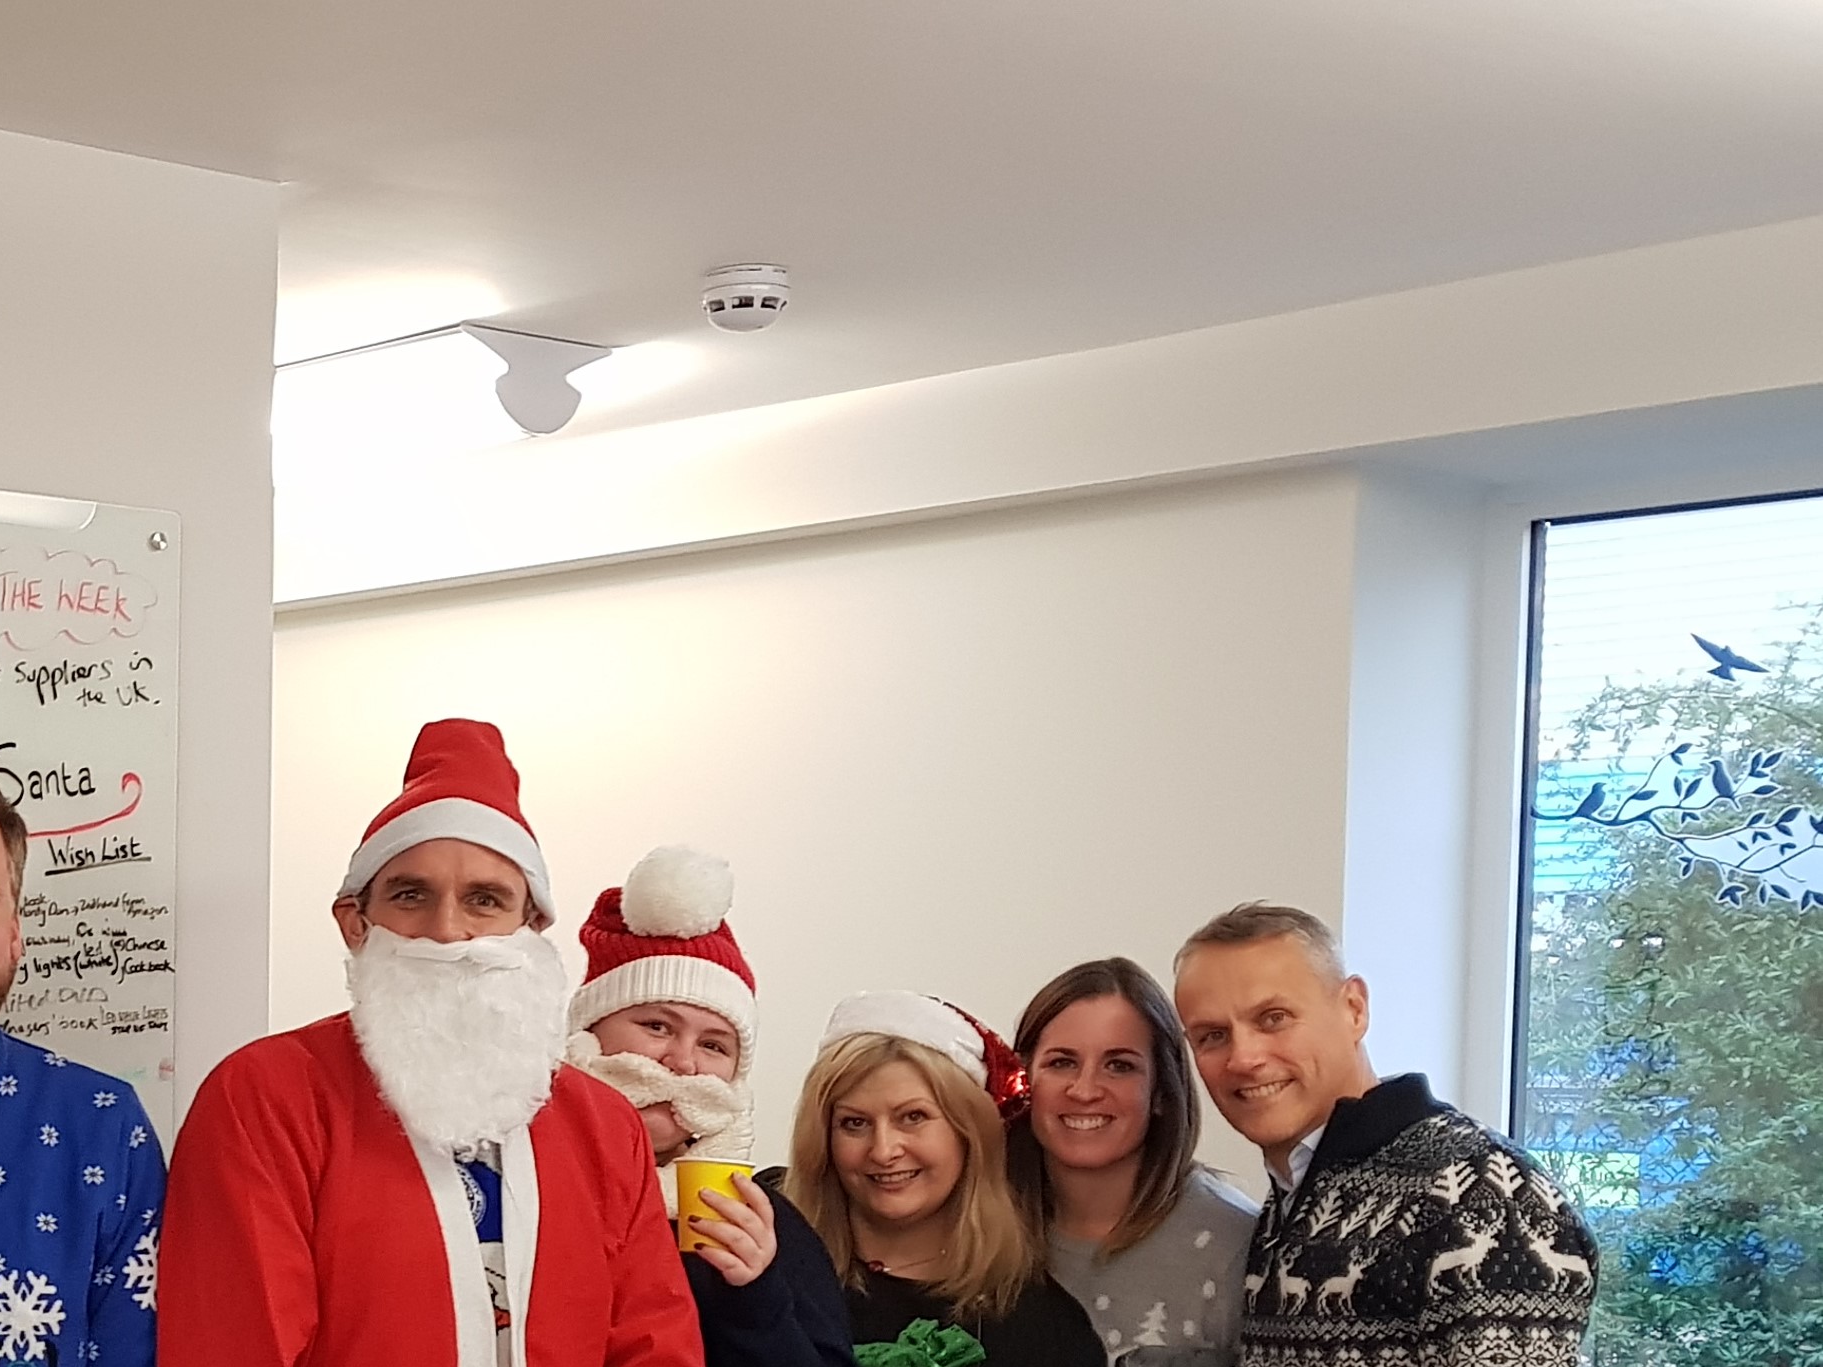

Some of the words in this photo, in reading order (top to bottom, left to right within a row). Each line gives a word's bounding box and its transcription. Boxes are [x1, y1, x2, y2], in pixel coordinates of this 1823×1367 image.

[58, 579, 133, 623] WEEK
[129, 651, 154, 672] in
[47, 835, 96, 868] Wish
[101, 835, 143, 862] List
